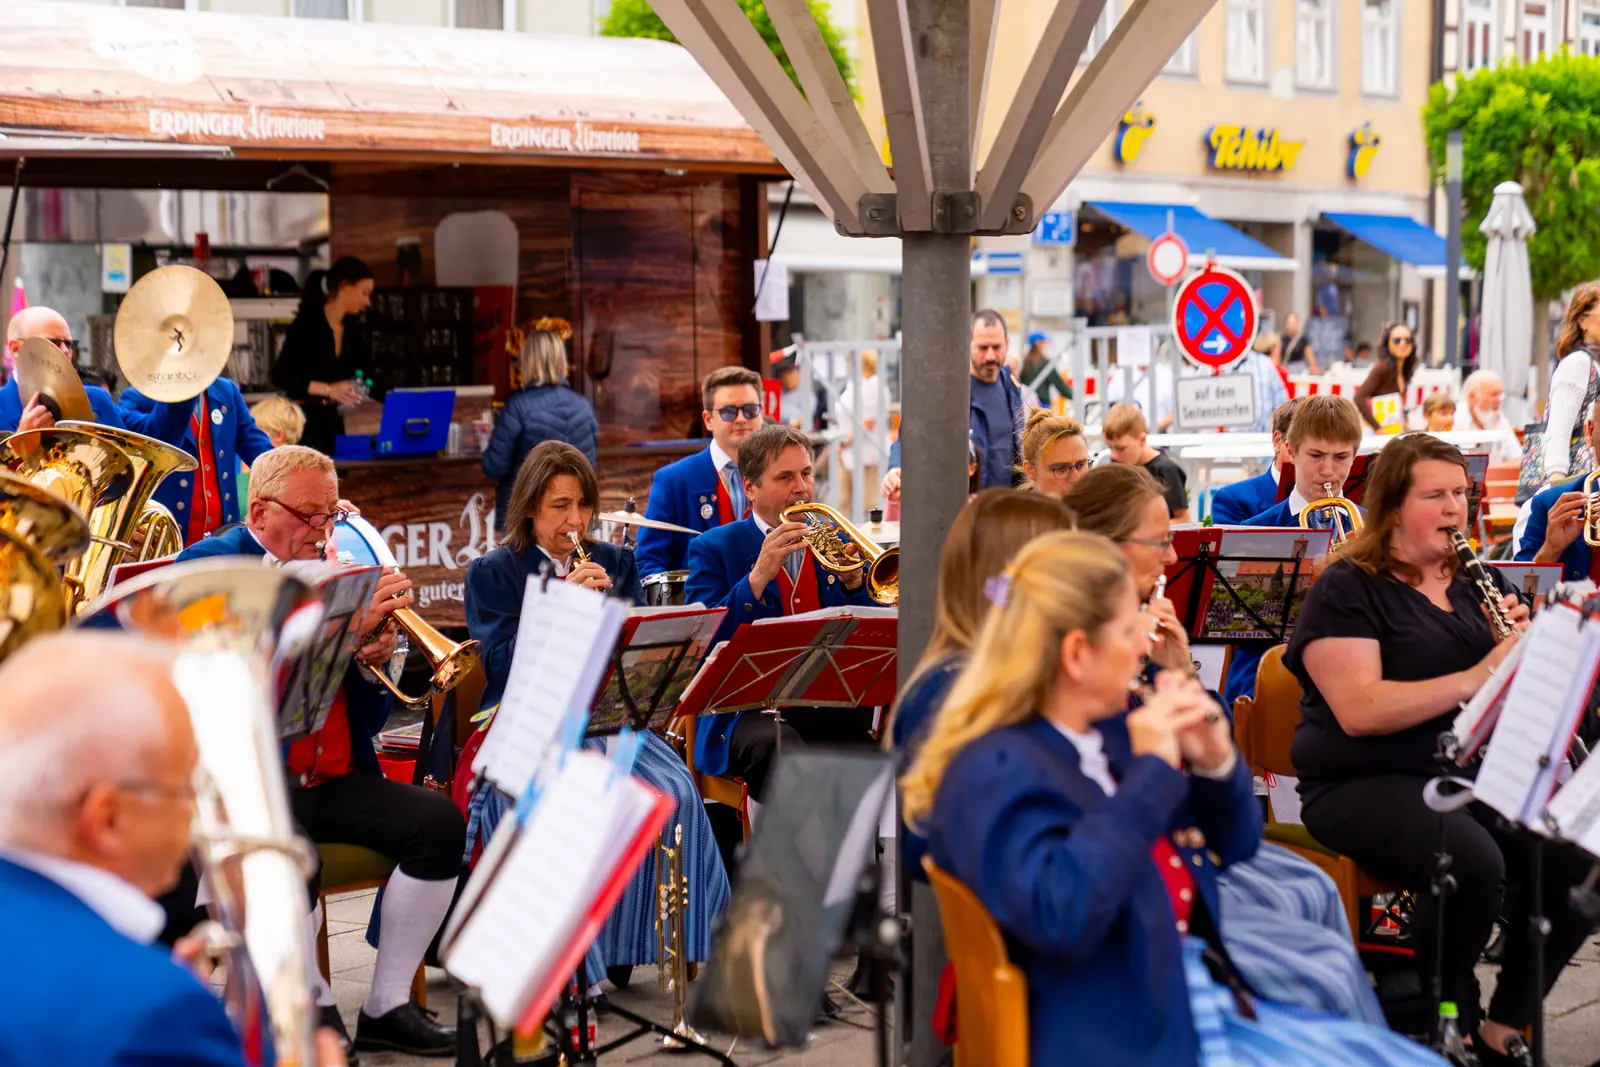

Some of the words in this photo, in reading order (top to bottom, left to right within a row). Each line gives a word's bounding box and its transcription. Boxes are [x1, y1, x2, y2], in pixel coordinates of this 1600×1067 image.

[149, 107, 247, 138] ERDINGER
[491, 122, 573, 151] ERDINGER
[1204, 125, 1304, 172] Tchibo
[1195, 387, 1209, 401] auf
[1215, 387, 1235, 399] dem
[1182, 404, 1249, 419] Seitenstreifen
